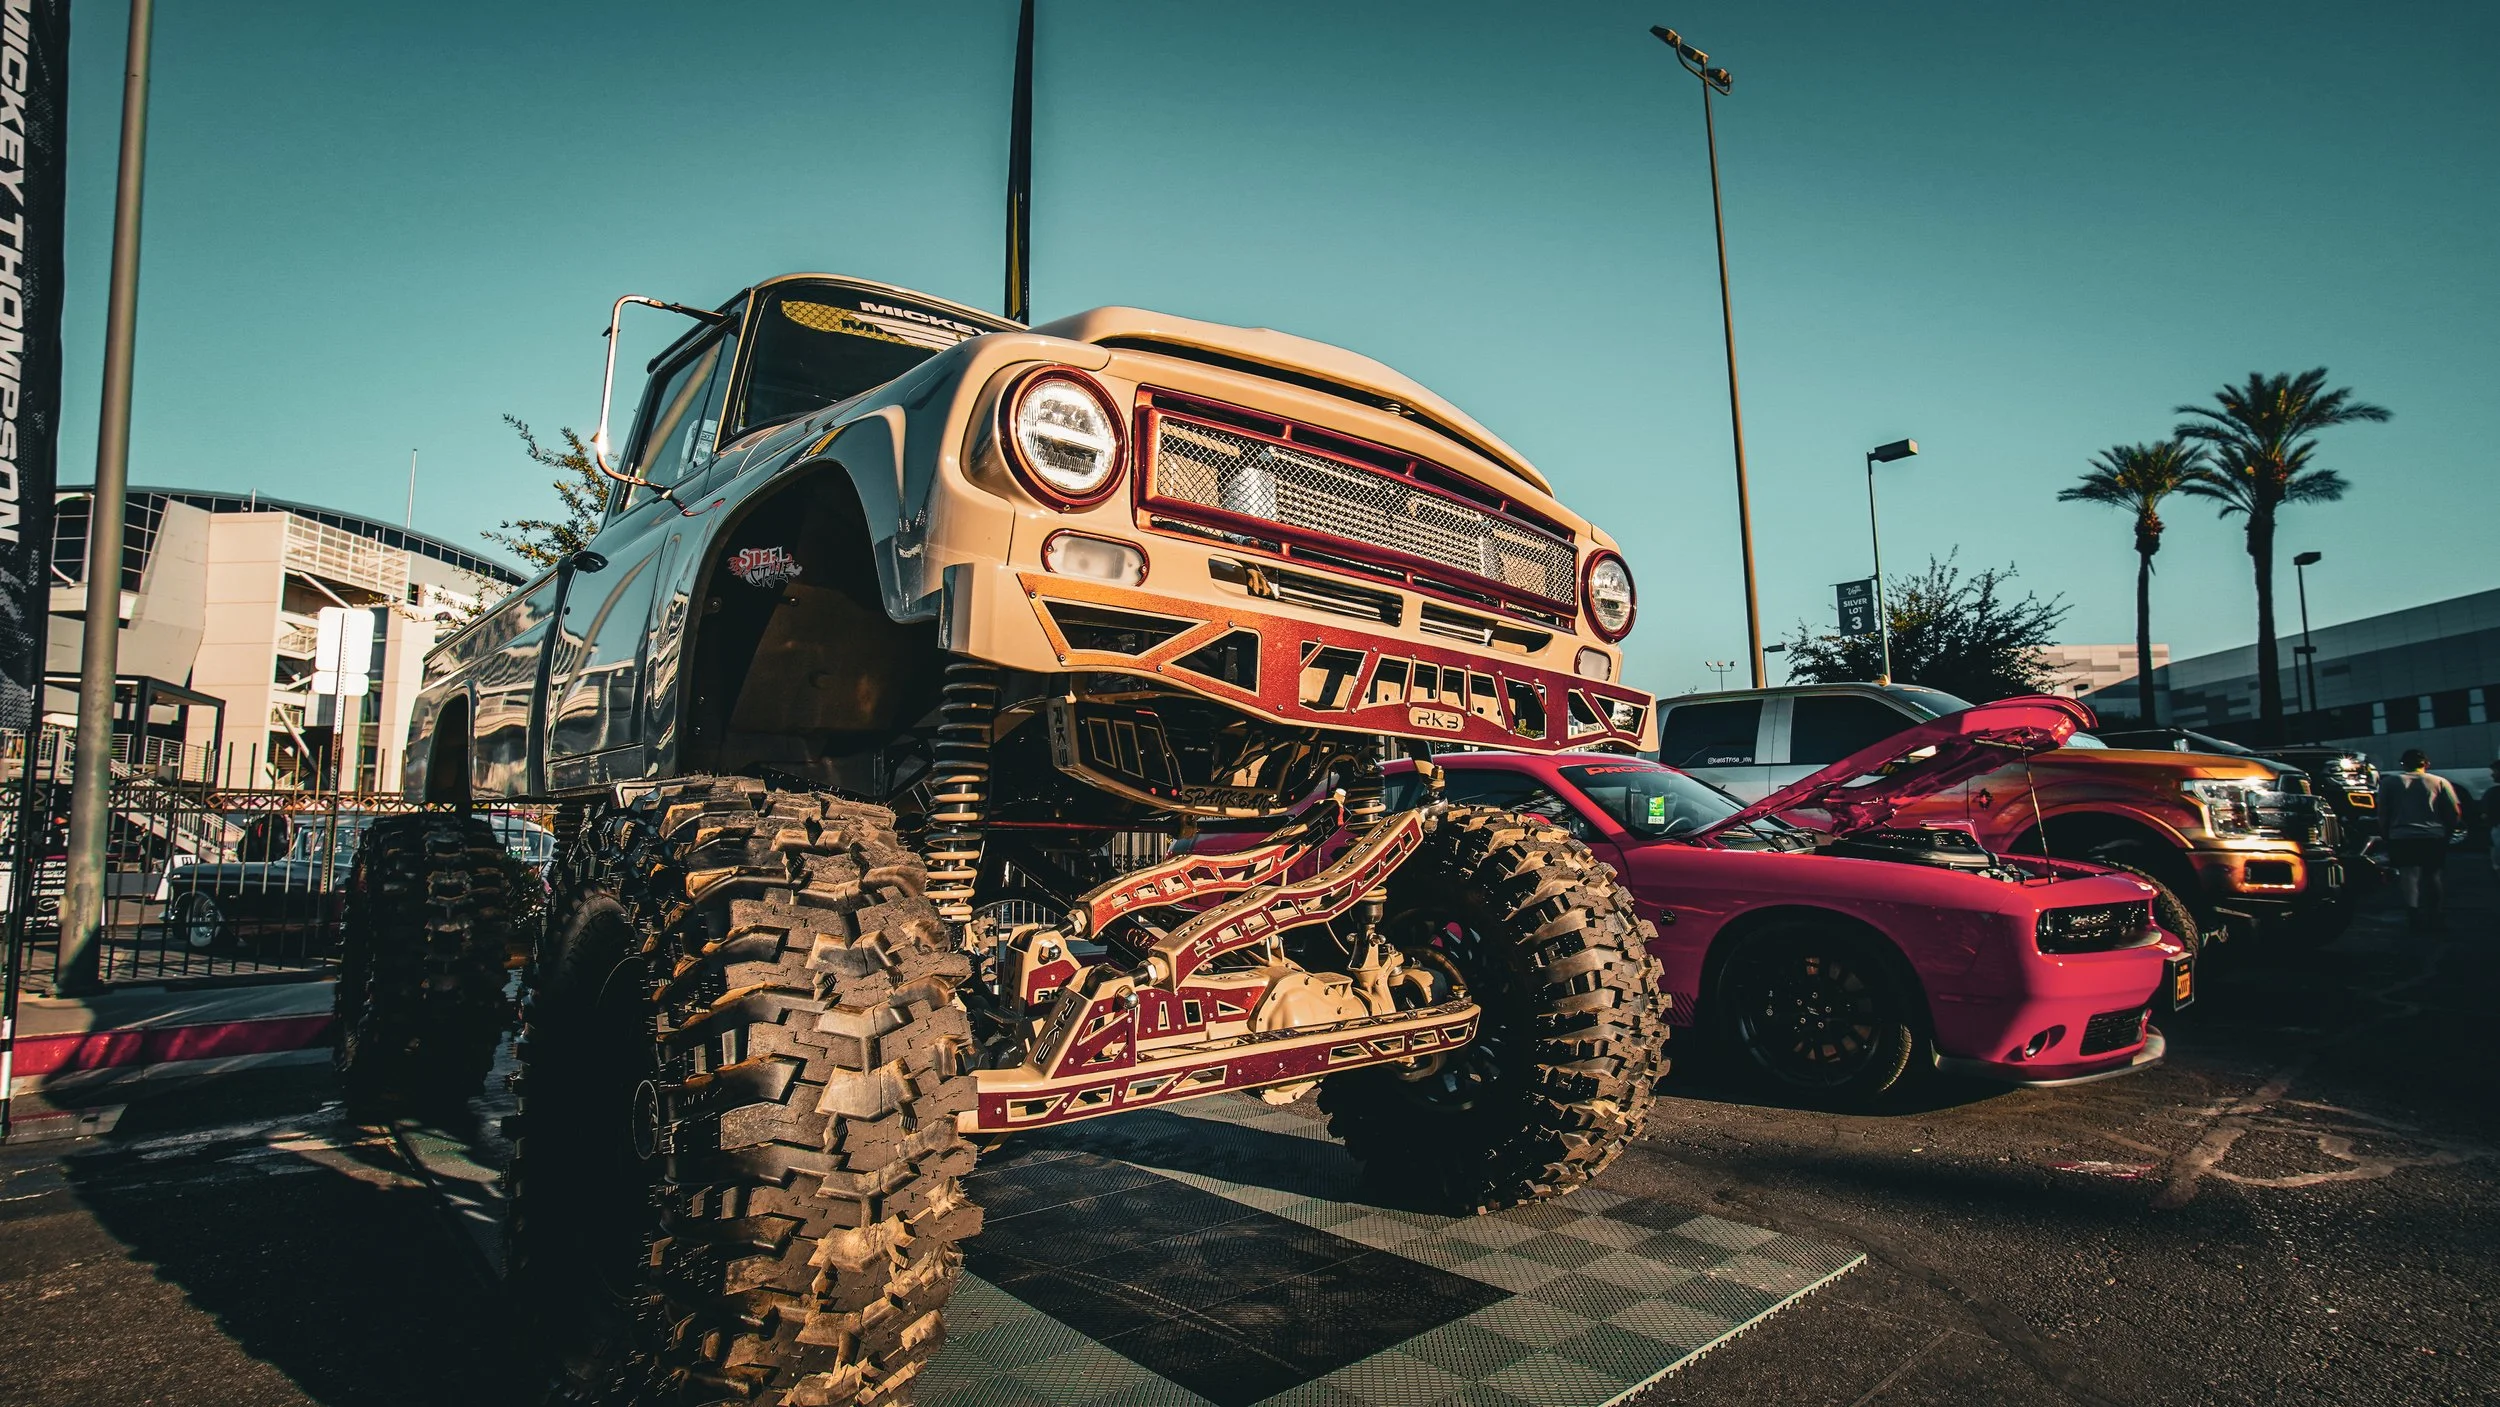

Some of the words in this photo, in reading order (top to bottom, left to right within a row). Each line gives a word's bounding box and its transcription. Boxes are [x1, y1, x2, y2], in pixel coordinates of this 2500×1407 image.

[0, 0, 31, 206] MICKEY
[0, 213, 25, 543] THOMPSON
[738, 546, 792, 569] STEEL
[1843, 598, 1868, 607] SILVER
[1849, 607, 1863, 615] LOT
[1851, 616, 1863, 630] 3
